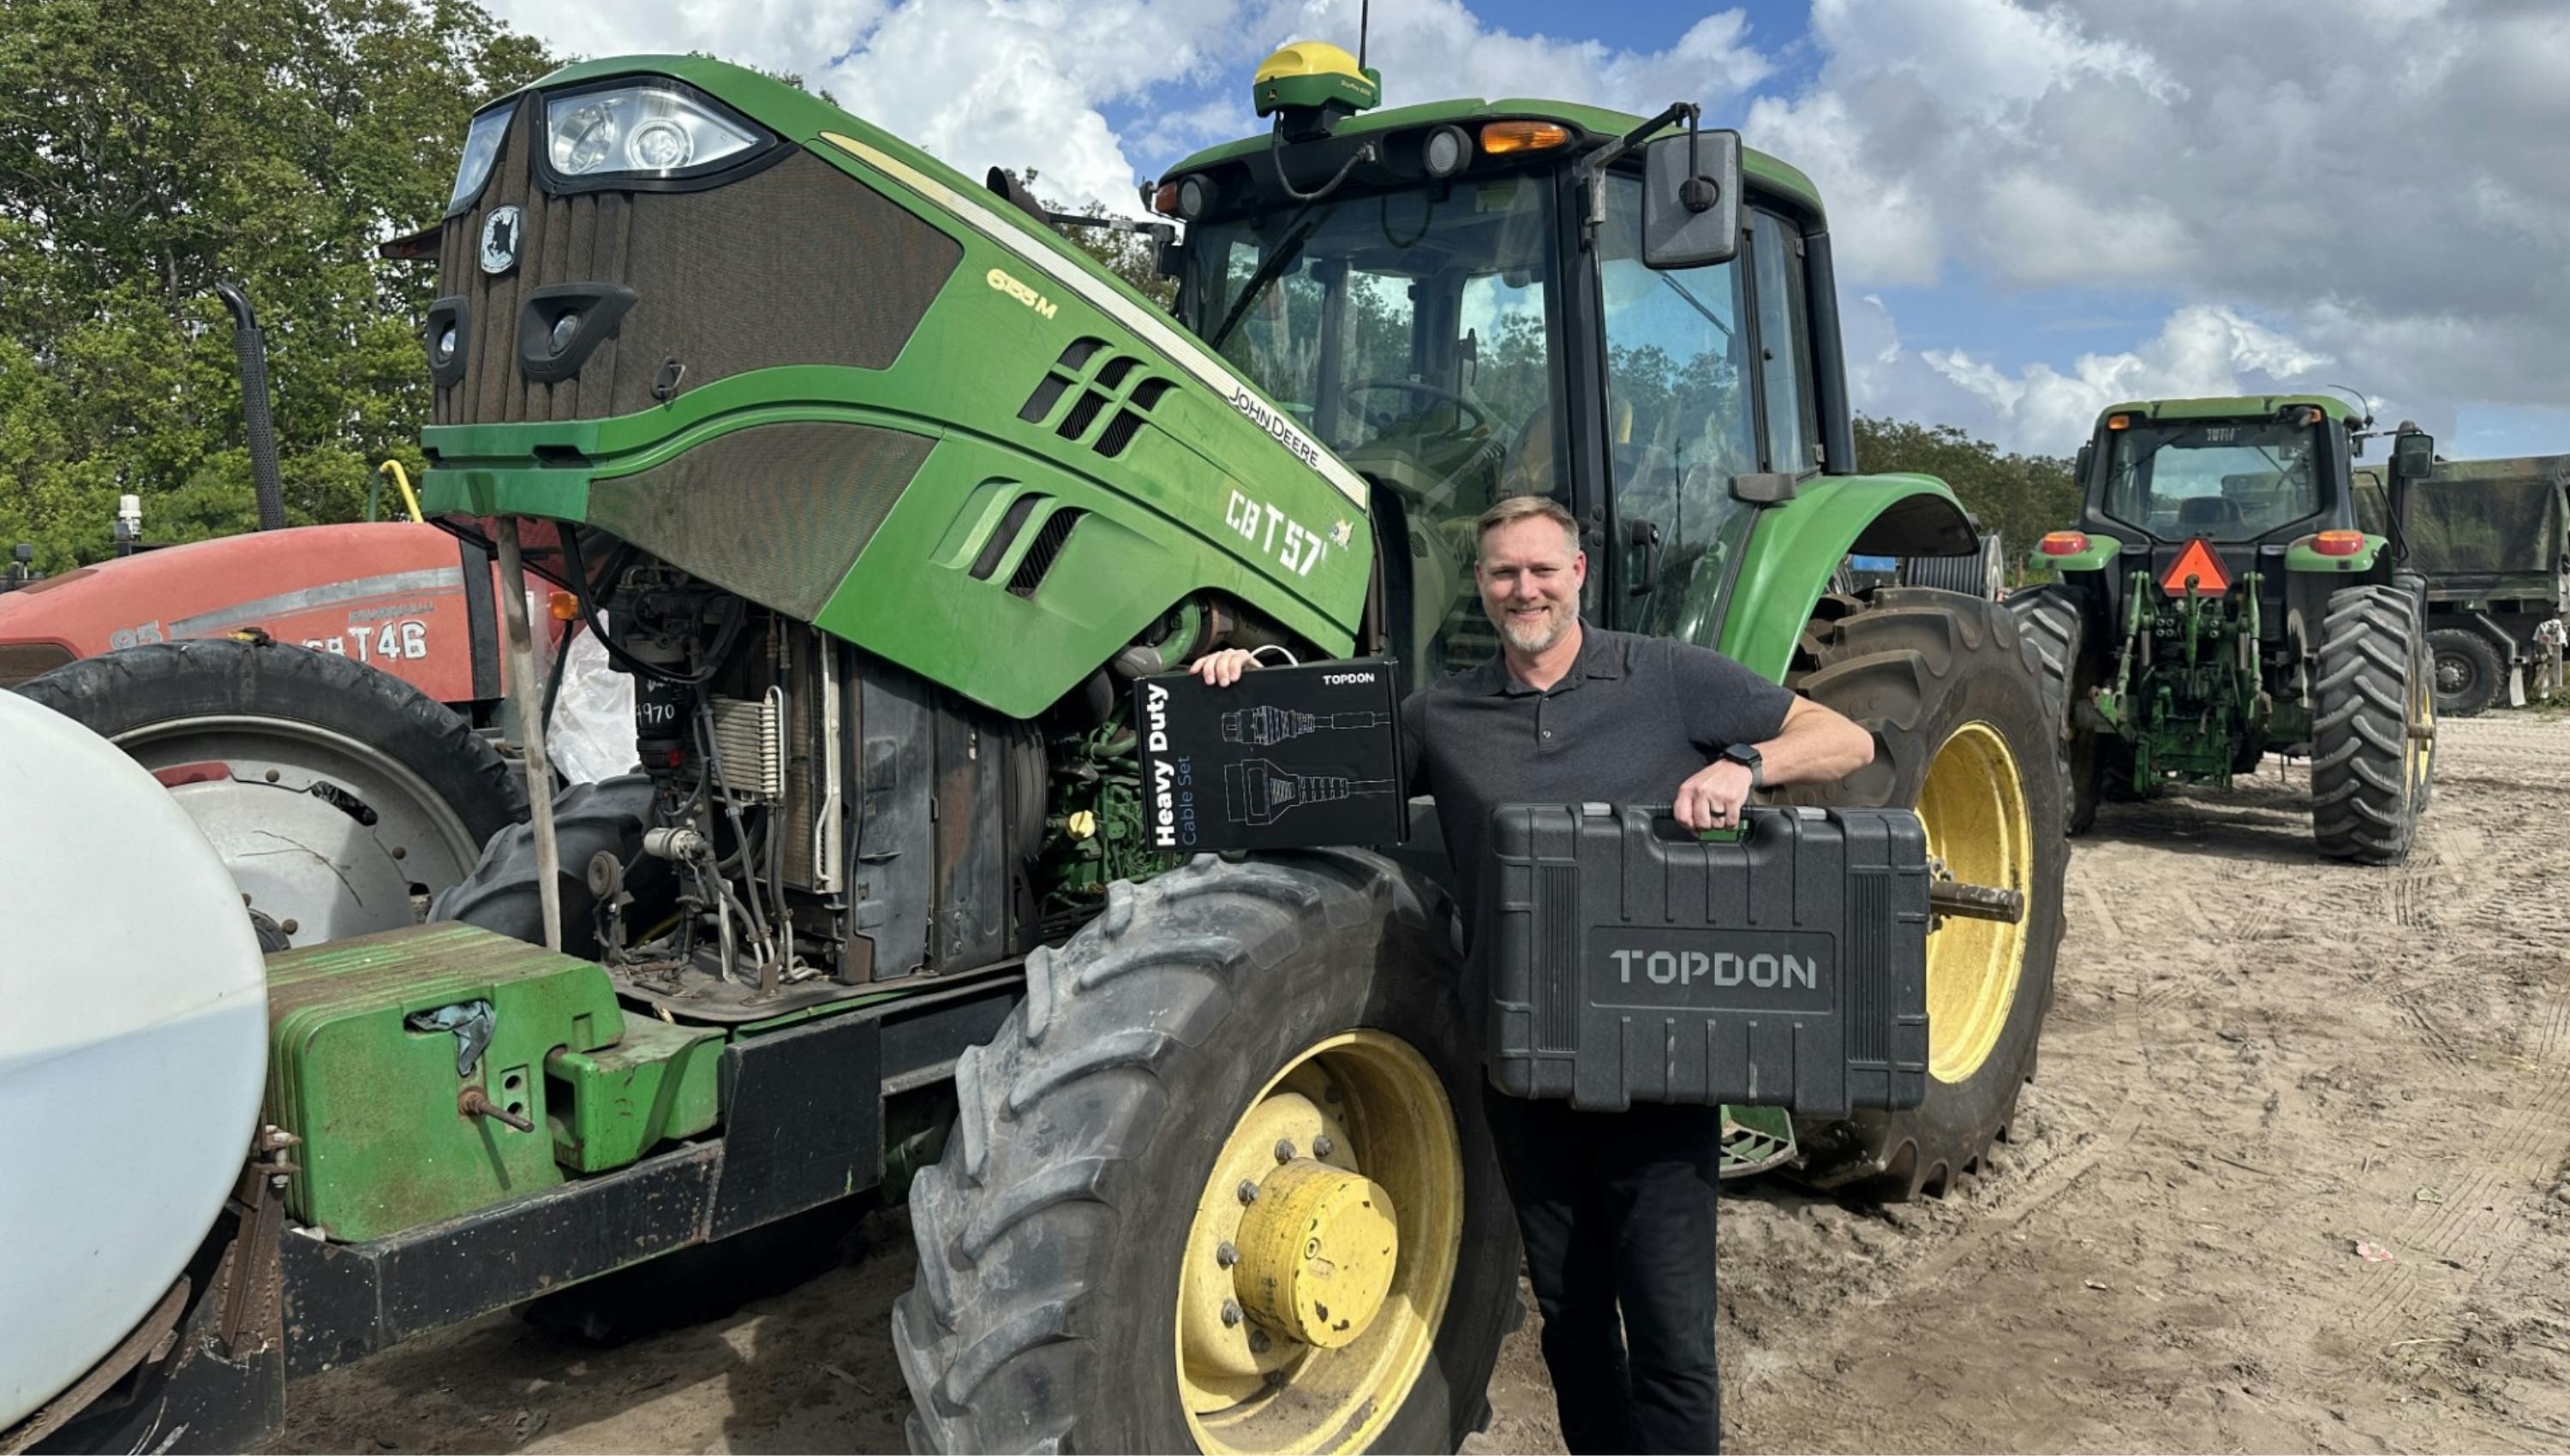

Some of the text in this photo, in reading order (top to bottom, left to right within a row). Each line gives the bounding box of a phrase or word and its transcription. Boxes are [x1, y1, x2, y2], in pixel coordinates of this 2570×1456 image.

[1228, 386, 1319, 468] JOHN DEERE
[1322, 672, 1375, 685] TOPDON
[1147, 683, 1175, 846] Heavy Duty
[1177, 755, 1197, 846] Cable Set
[1609, 949, 1817, 989] TOPDON
